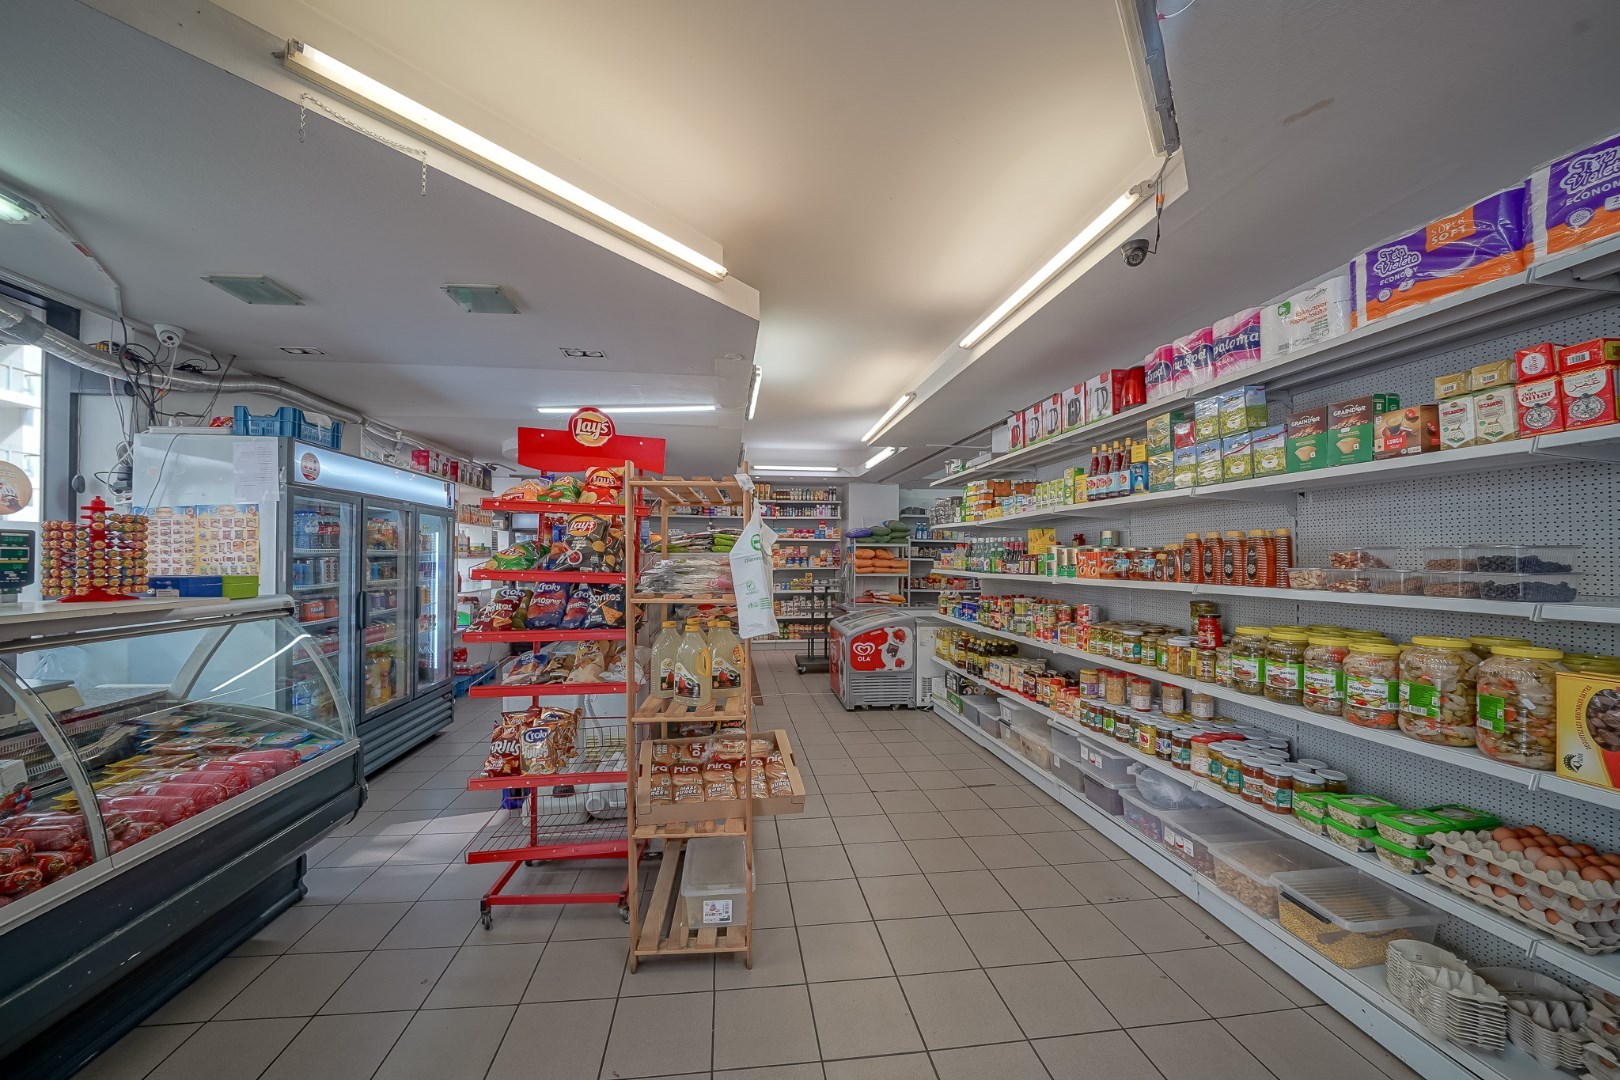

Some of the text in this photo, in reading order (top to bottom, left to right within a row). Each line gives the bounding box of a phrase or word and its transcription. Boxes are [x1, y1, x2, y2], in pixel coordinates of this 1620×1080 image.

[1564, 160, 1620, 190] Violet
[1566, 180, 1620, 206] ECONOM
[1432, 217, 1465, 236] SUPER
[1432, 224, 1467, 245] SOFT
[1375, 253, 1418, 274] Violeta
[1380, 267, 1418, 286] ECONOY
[1213, 332, 1260, 357] paloma
[1521, 390, 1553, 403] omar
[576, 418, 610, 440] Lay's
[651, 764, 668, 772] ira
[674, 765, 699, 774] nira
[707, 762, 732, 771] nira
[740, 758, 763, 768] nra
